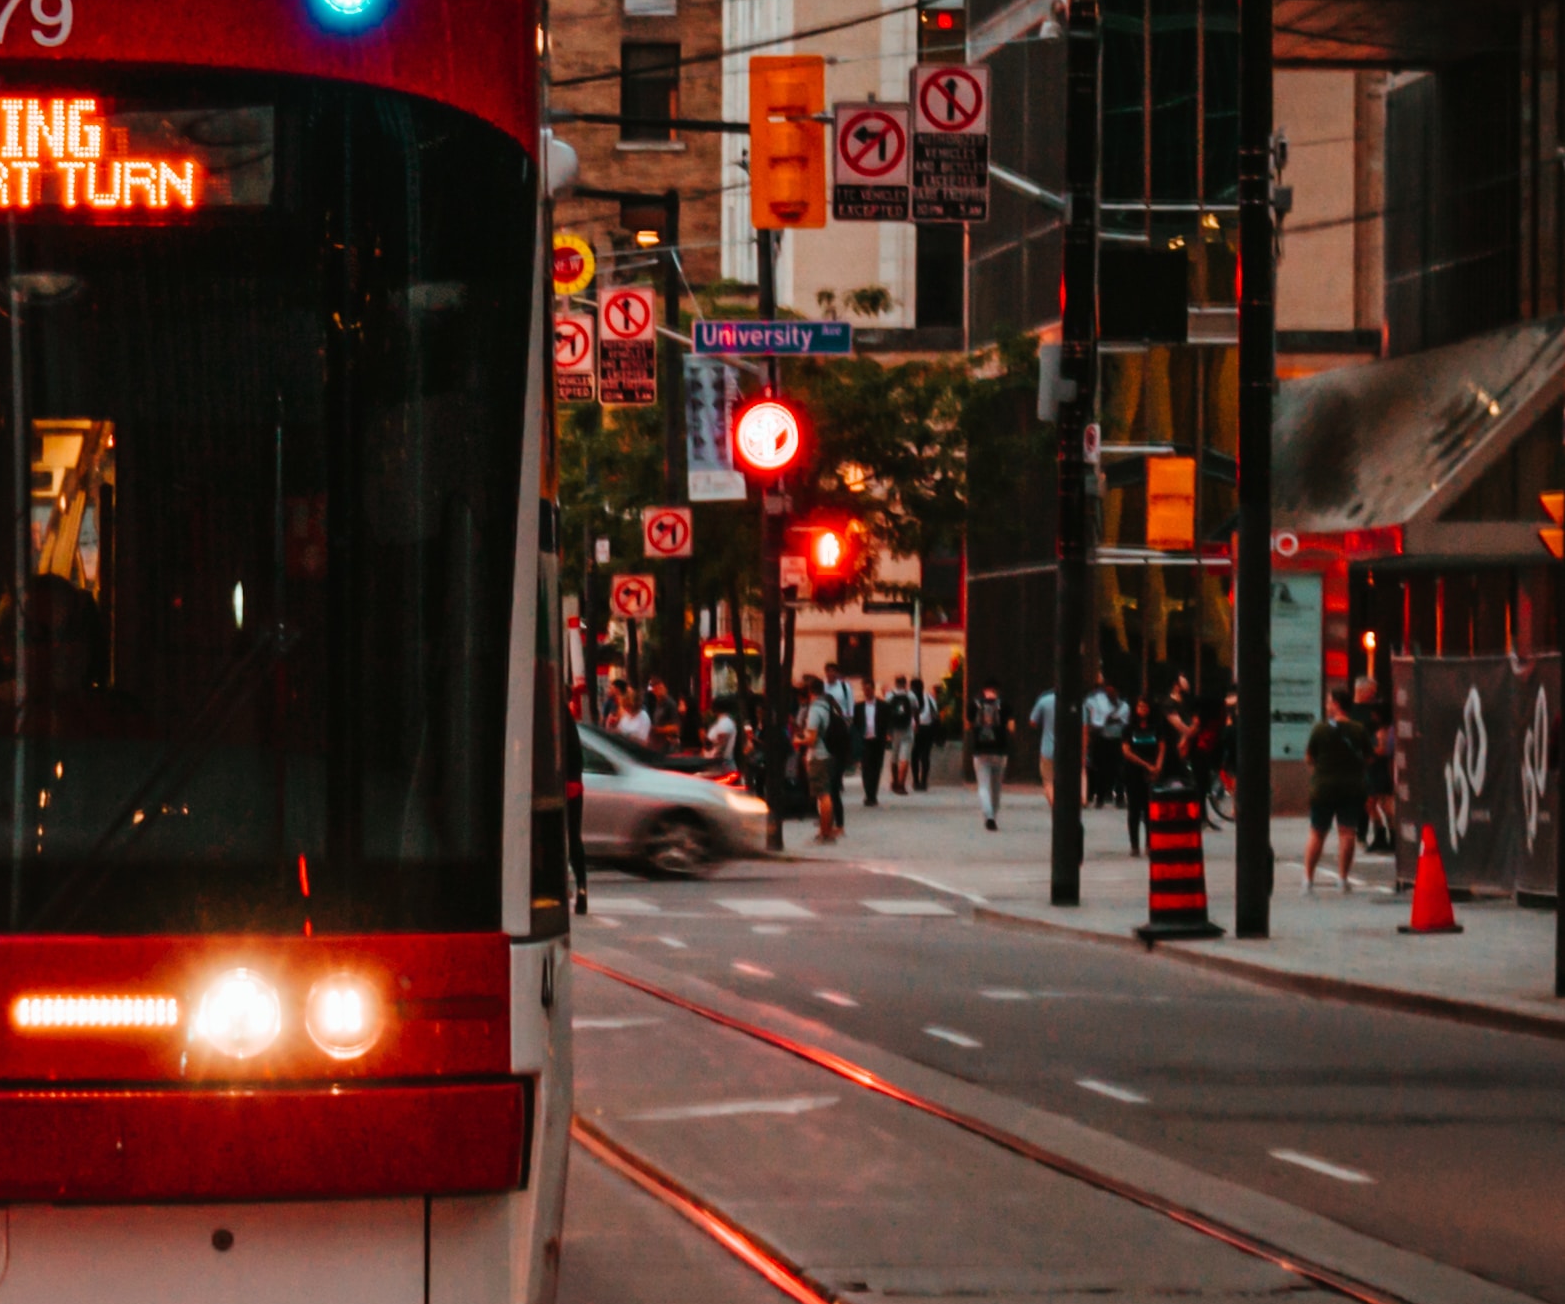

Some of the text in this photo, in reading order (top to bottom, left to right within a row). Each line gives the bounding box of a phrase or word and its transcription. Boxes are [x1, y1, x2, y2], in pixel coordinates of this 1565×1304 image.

[57, 161, 195, 208] TURN
[860, 189, 907, 201] VEHICLES
[838, 204, 904, 216] EXCEPTED
[702, 323, 814, 352] University
